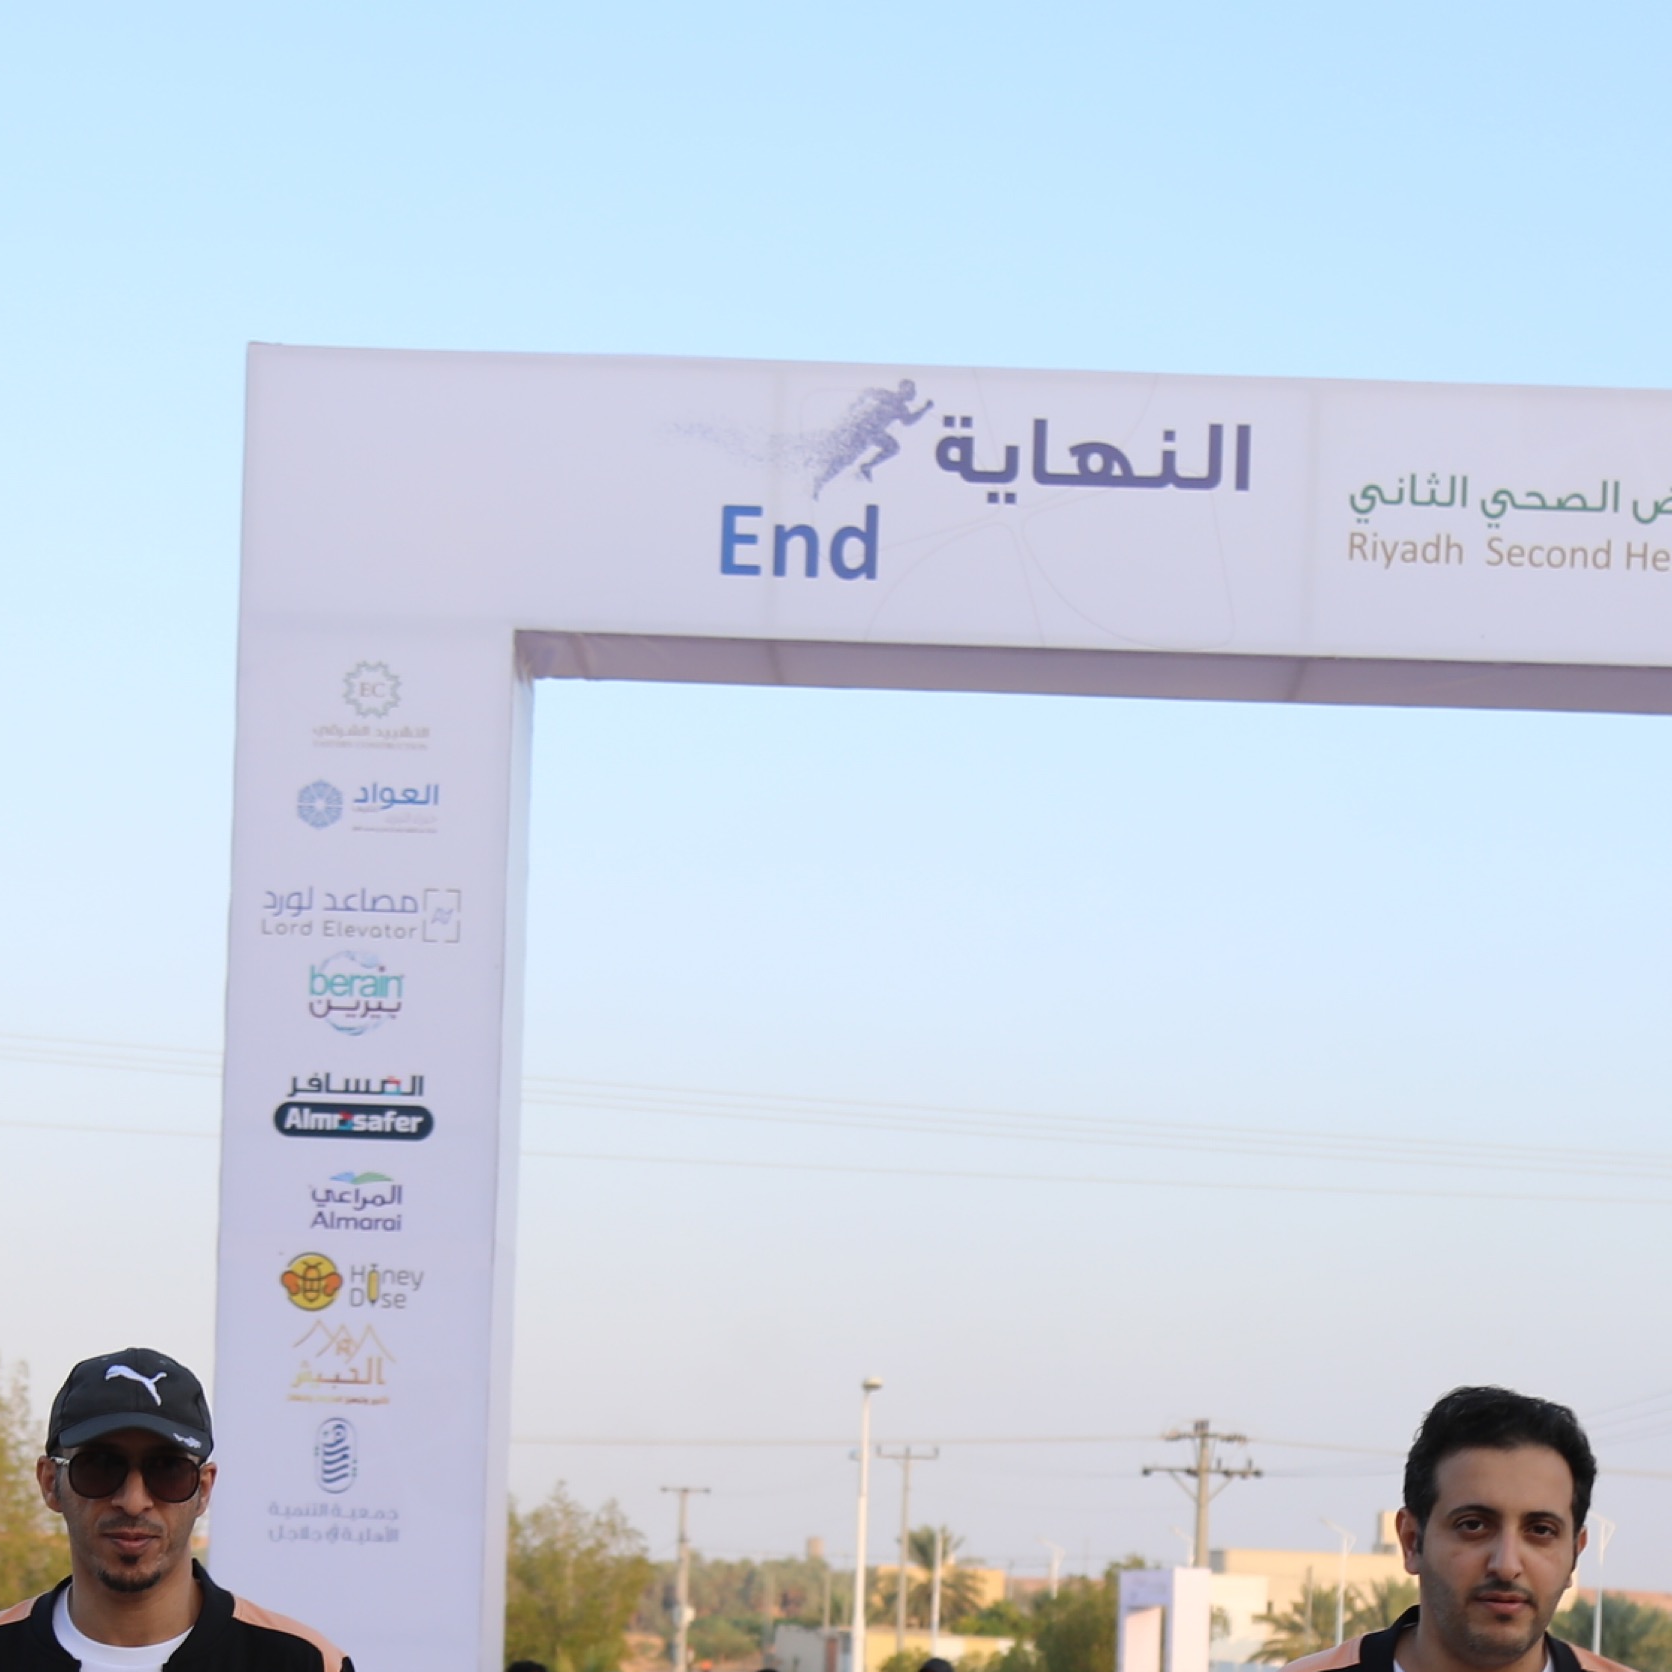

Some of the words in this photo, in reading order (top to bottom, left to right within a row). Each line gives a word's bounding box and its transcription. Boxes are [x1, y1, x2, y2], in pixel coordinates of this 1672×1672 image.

[934, 413, 1252, 505] النهاية
[1349, 472, 1468, 524] الثاني
[1480, 480, 1621, 529] الصحي
[720, 503, 880, 580] End
[1348, 532, 1464, 570] Riyadh
[1485, 535, 1612, 570] Second
[352, 782, 439, 809] العواد
[263, 886, 314, 917] لورد
[322, 887, 419, 914] مصاعد
[261, 918, 314, 936] Lord
[323, 920, 418, 939] Elevator
[309, 964, 403, 998] berain
[310, 1184, 403, 1211] المراعي
[310, 1211, 402, 1232] Almarai
